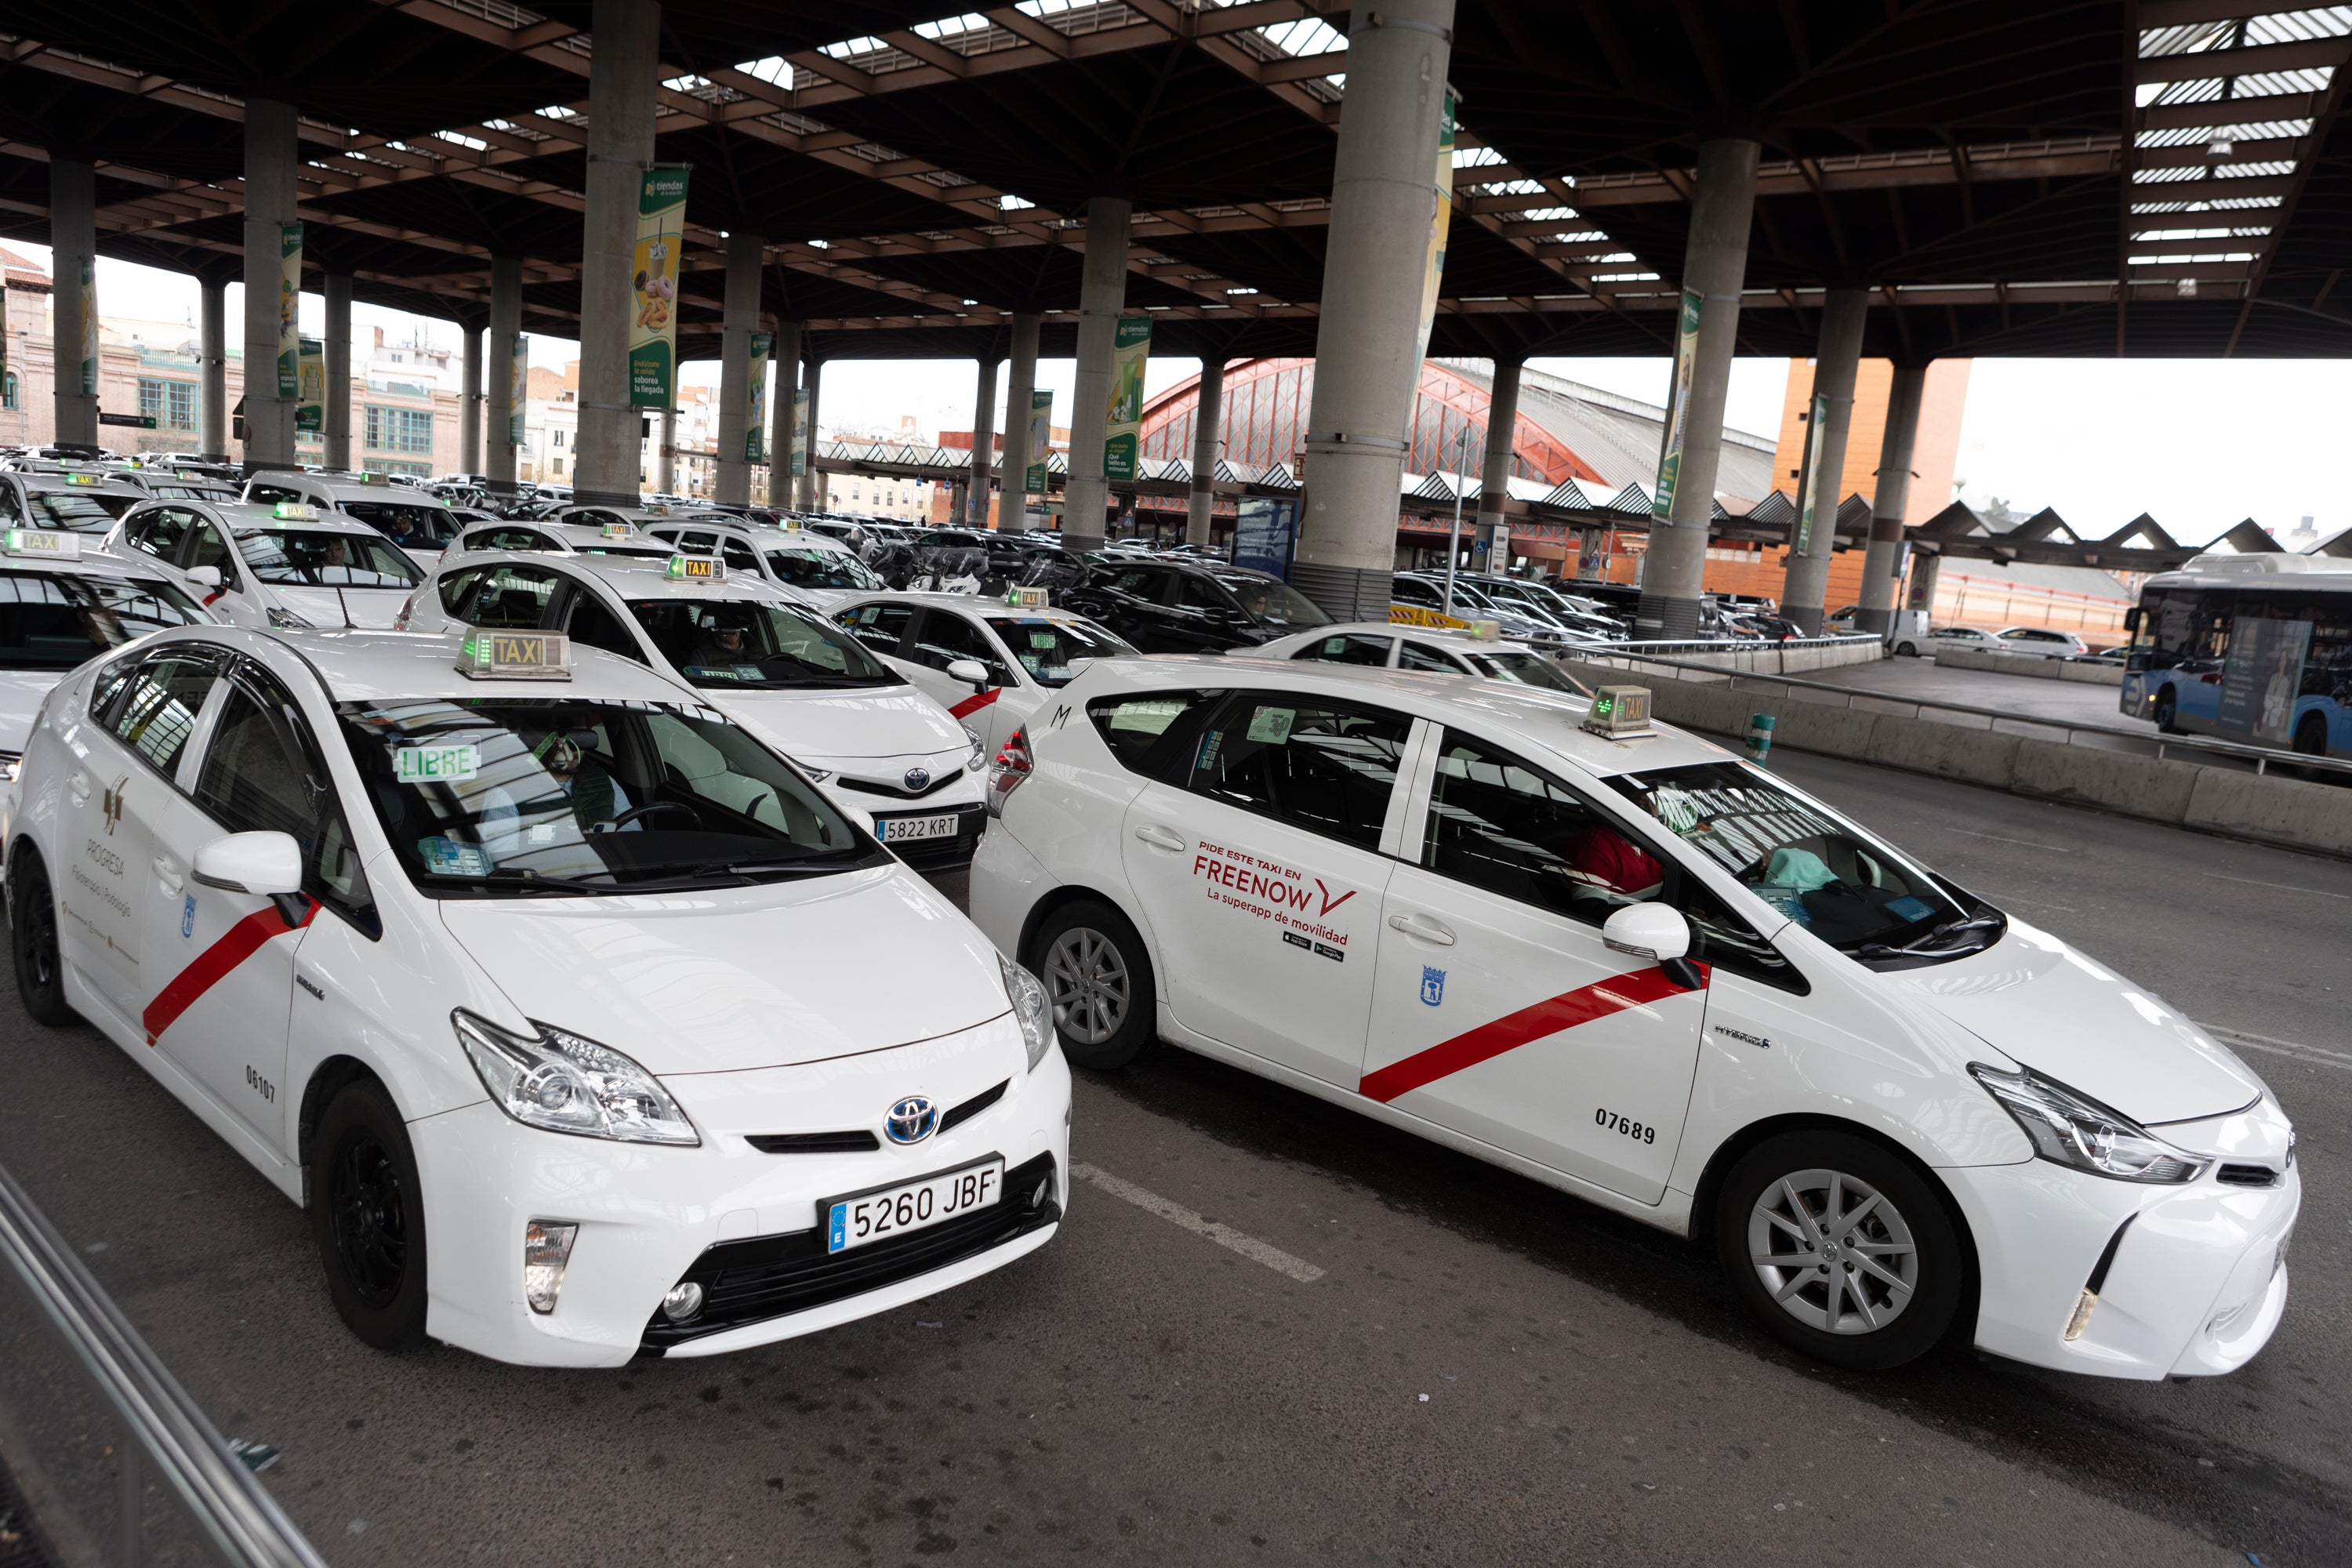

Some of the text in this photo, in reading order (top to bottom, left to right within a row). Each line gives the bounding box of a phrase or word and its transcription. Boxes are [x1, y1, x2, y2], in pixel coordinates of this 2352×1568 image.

[656, 181, 684, 191] tiendas
[633, 376, 659, 385] saborea
[634, 384, 664, 395] la llegada
[288, 506, 305, 516] TAXI
[611, 525, 626, 534] TAXI
[24, 534, 59, 549] TAXI
[687, 561, 710, 576] TAXI
[1023, 593, 1039, 604] TAXI
[495, 638, 542, 663] TAXI
[1033, 634, 1054, 648] LIBRE
[1050, 704, 1072, 730] M
[1625, 696, 1644, 719] TAXI
[403, 749, 470, 775] LIBRE
[887, 820, 925, 839] 5822
[929, 817, 955, 836] KRT
[87, 838, 124, 879] PROGRESA
[1198, 840, 1301, 881] PIDE ESTE TAXI EN
[72, 864, 101, 896] Fisioterapia
[104, 887, 131, 918] Podología
[1193, 855, 1313, 912] FREENOW
[1207, 887, 1348, 946] La superapp de movilidad
[1322, 949, 1334, 957] Google
[246, 1064, 275, 1104] 06107
[1595, 1108, 1655, 1145] 07689
[833, 1231, 842, 1243] E
[855, 1186, 934, 1238] 5260
[943, 1168, 995, 1214] JBF
